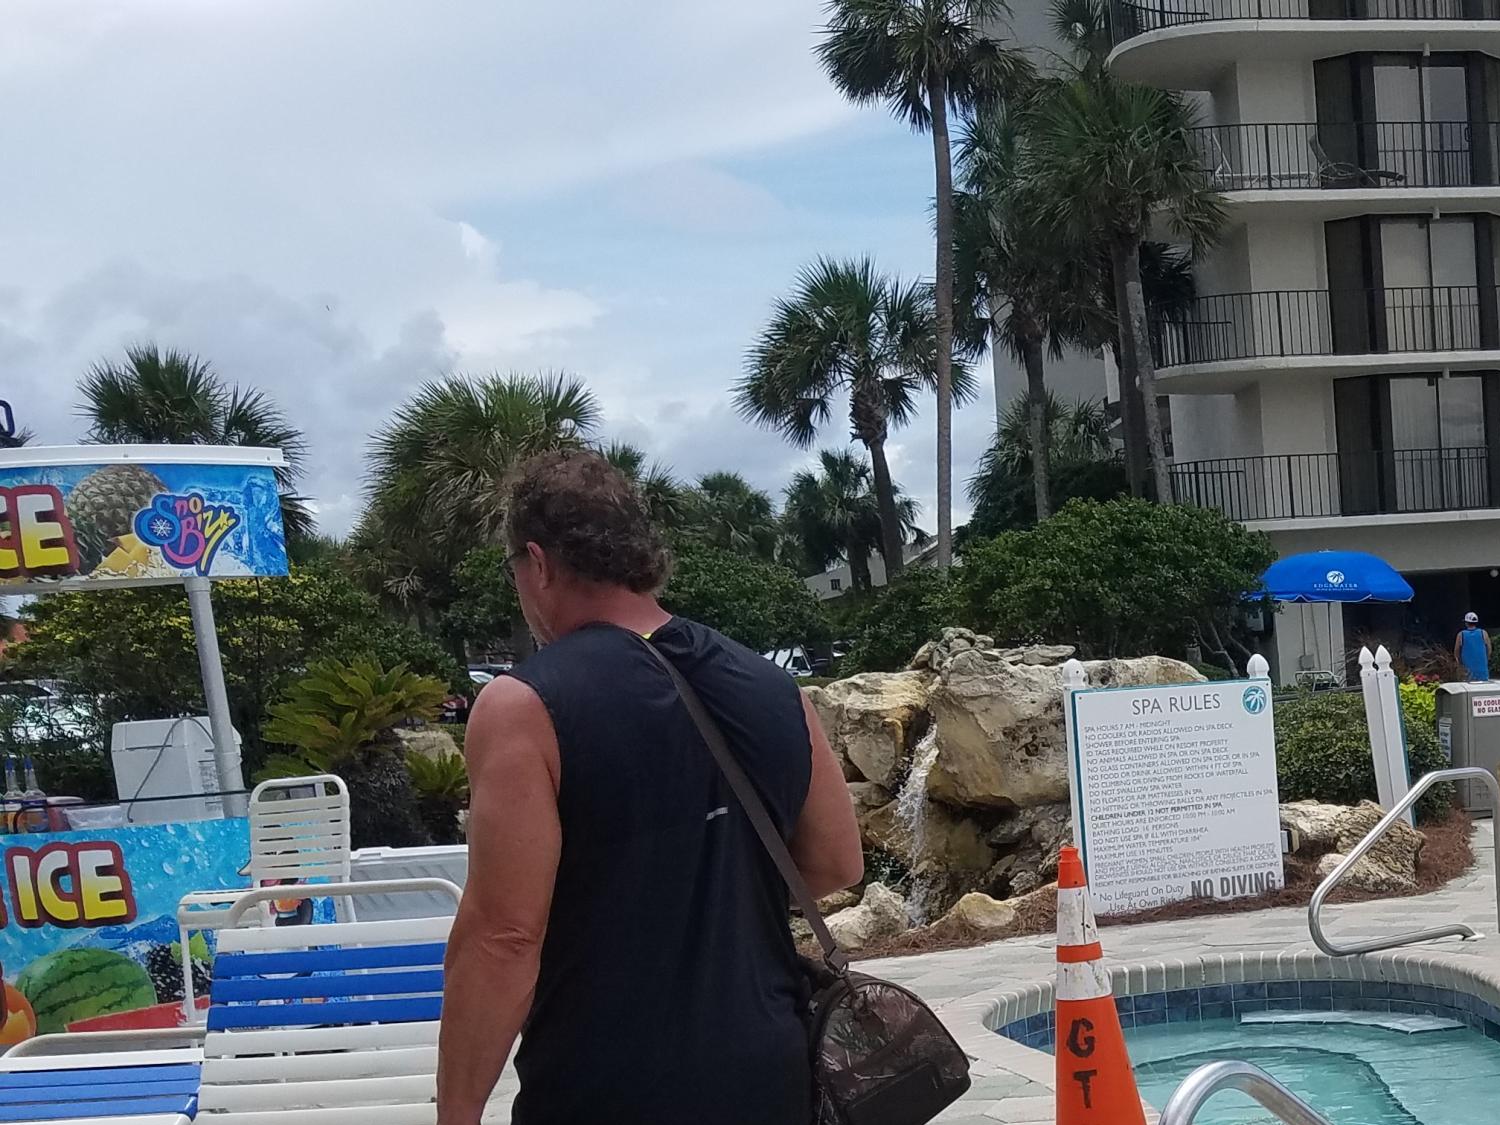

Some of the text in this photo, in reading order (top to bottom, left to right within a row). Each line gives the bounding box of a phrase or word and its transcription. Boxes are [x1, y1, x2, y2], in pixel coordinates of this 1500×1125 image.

[1132, 693, 1221, 716] SPA RULES
[12, 849, 128, 922] ICE
[1099, 883, 1184, 902] No Lifeguard On Duty
[1191, 870, 1276, 898] NO DIVING
[1109, 901, 1126, 911] Use
[1127, 899, 1136, 909] At
[1138, 897, 1157, 907] Own
